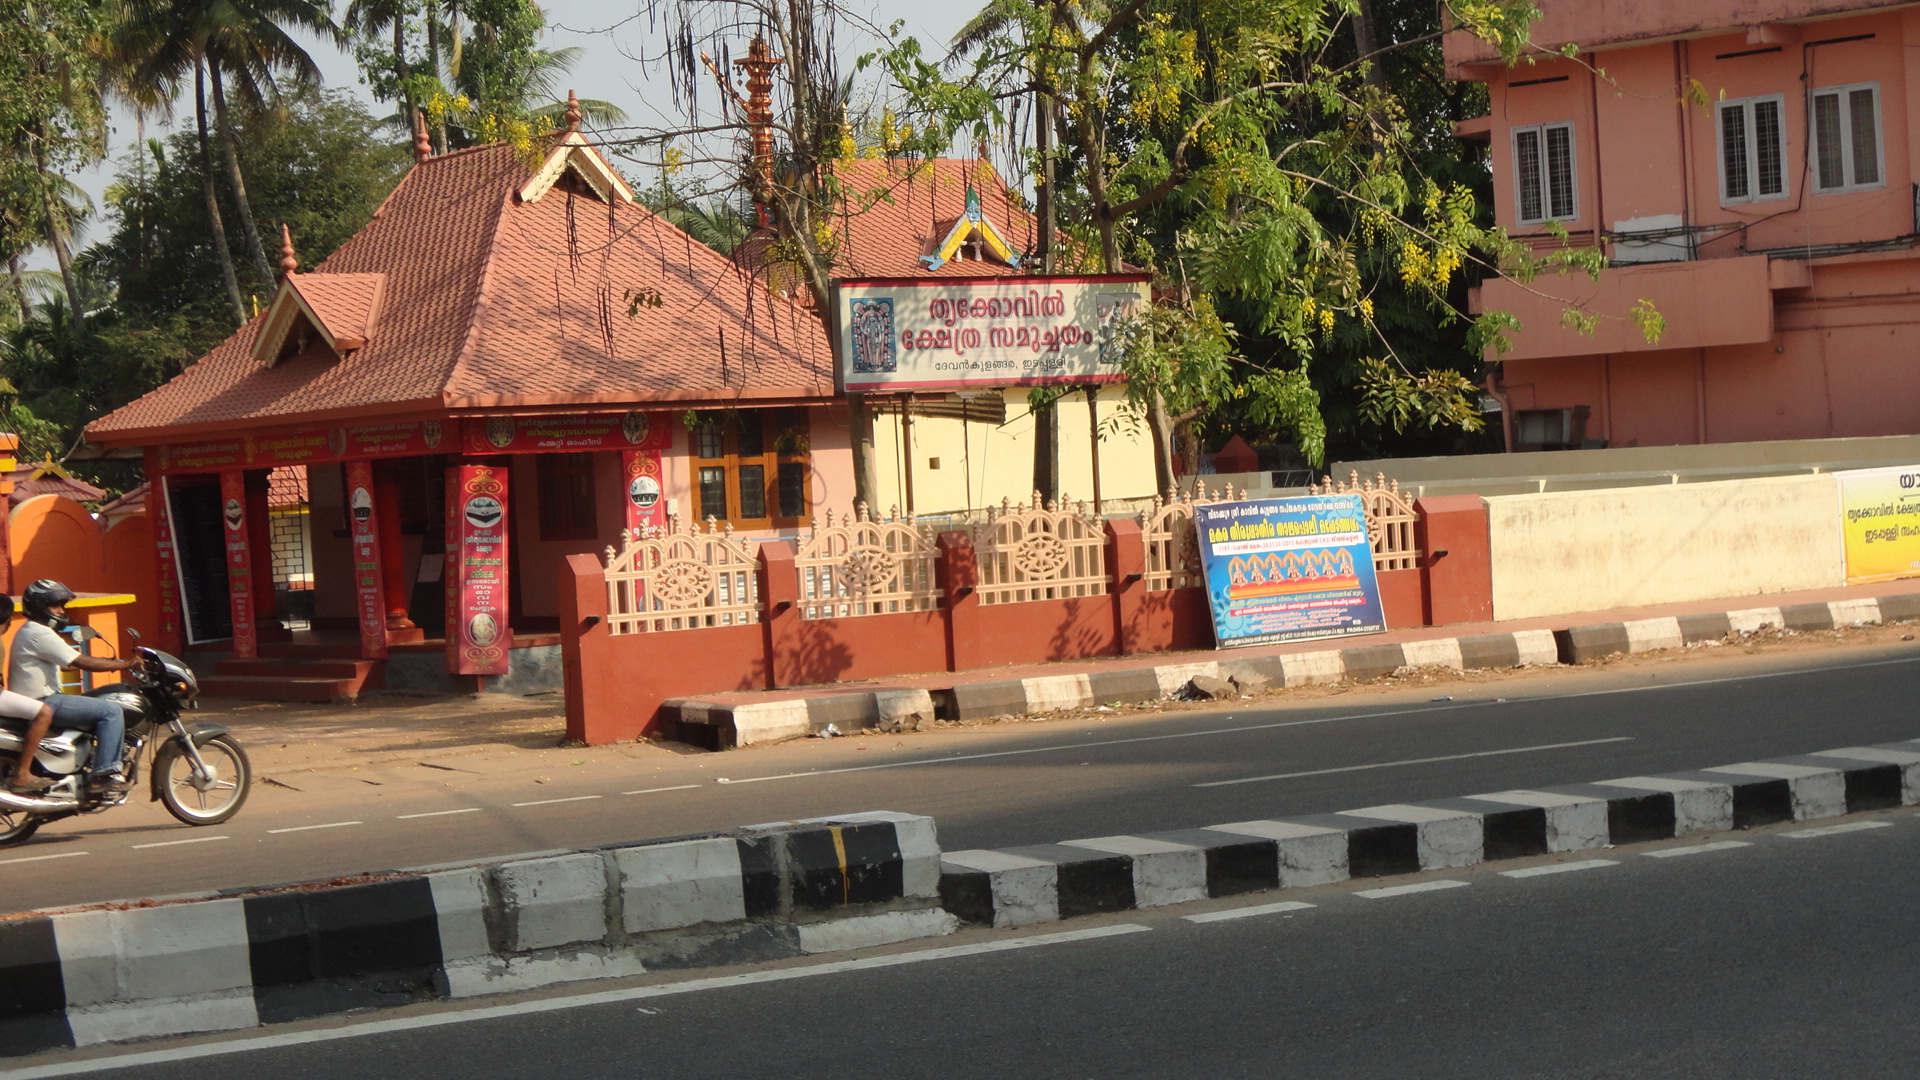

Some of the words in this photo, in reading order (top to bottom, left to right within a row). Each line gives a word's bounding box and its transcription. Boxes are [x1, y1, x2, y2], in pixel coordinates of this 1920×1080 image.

[929, 289, 1064, 327] തൃക്കോവിൽ
[901, 328, 980, 355] ക്ഷേത്ര
[989, 325, 1093, 353] സമുച്ചയം
[1023, 356, 1066, 371] ഇടപ്പള്ളി
[1847, 502, 1894, 523] തൃക്കോവിൽ
[1865, 523, 1899, 544] ഇടപ്പള്ളി
